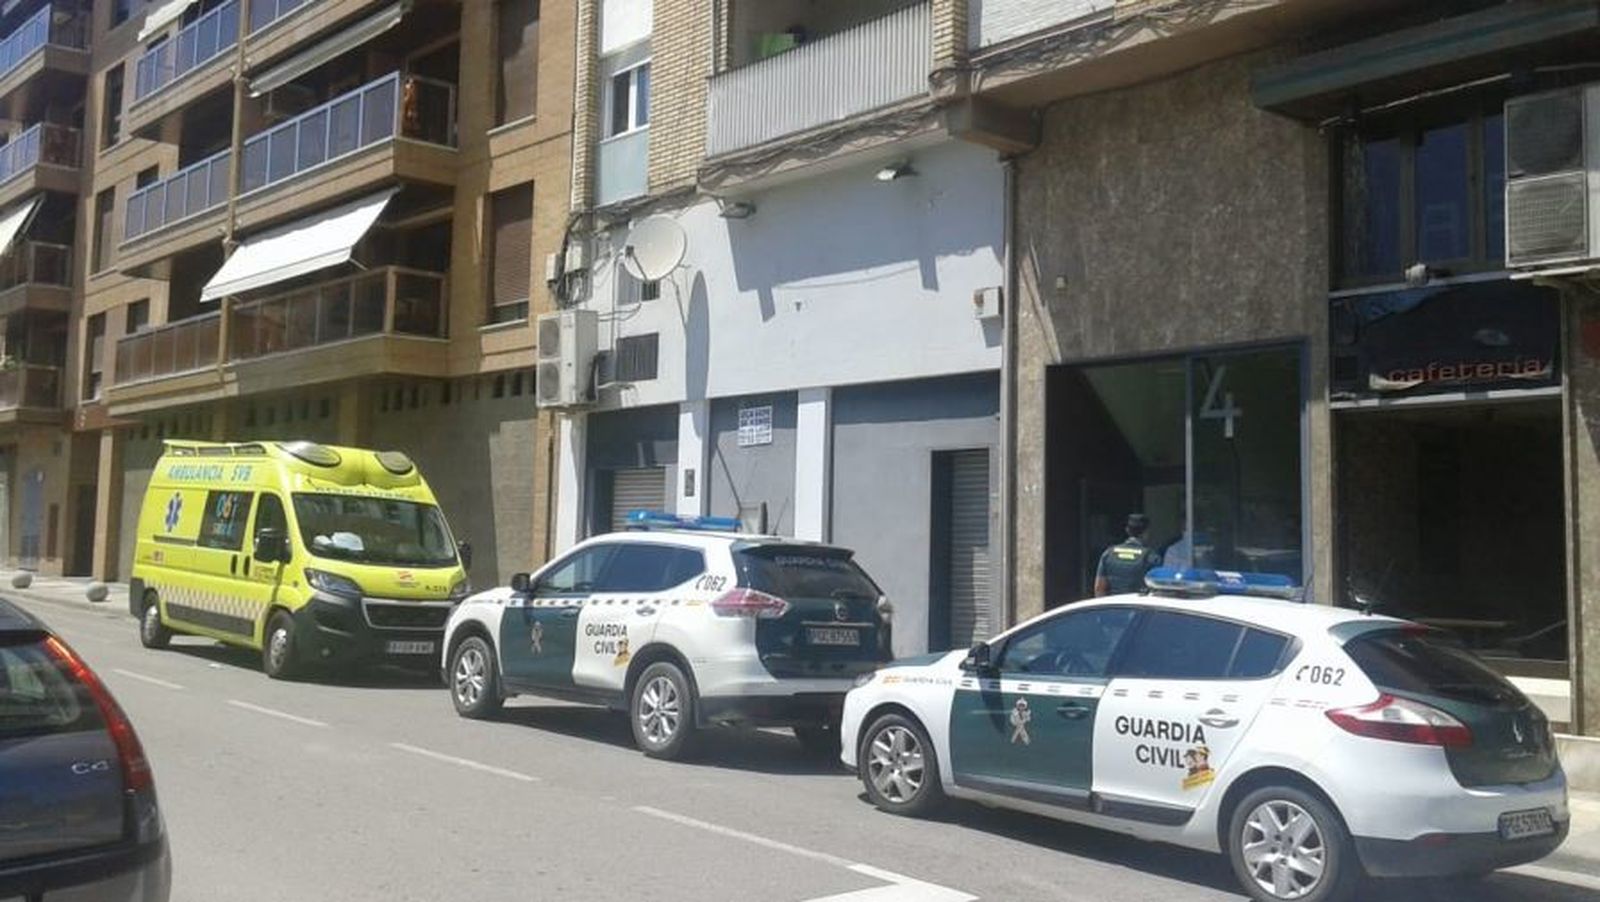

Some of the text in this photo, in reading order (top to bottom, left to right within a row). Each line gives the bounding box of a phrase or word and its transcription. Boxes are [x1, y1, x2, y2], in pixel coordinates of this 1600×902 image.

[1199, 364, 1243, 438] 4
[703, 576, 728, 593] 062
[585, 623, 629, 638] GUARDIA
[594, 640, 618, 655] CIVIL
[1310, 665, 1346, 687] 062
[1115, 715, 1207, 745] GUARDIA
[1135, 744, 1185, 769] CIVIL
